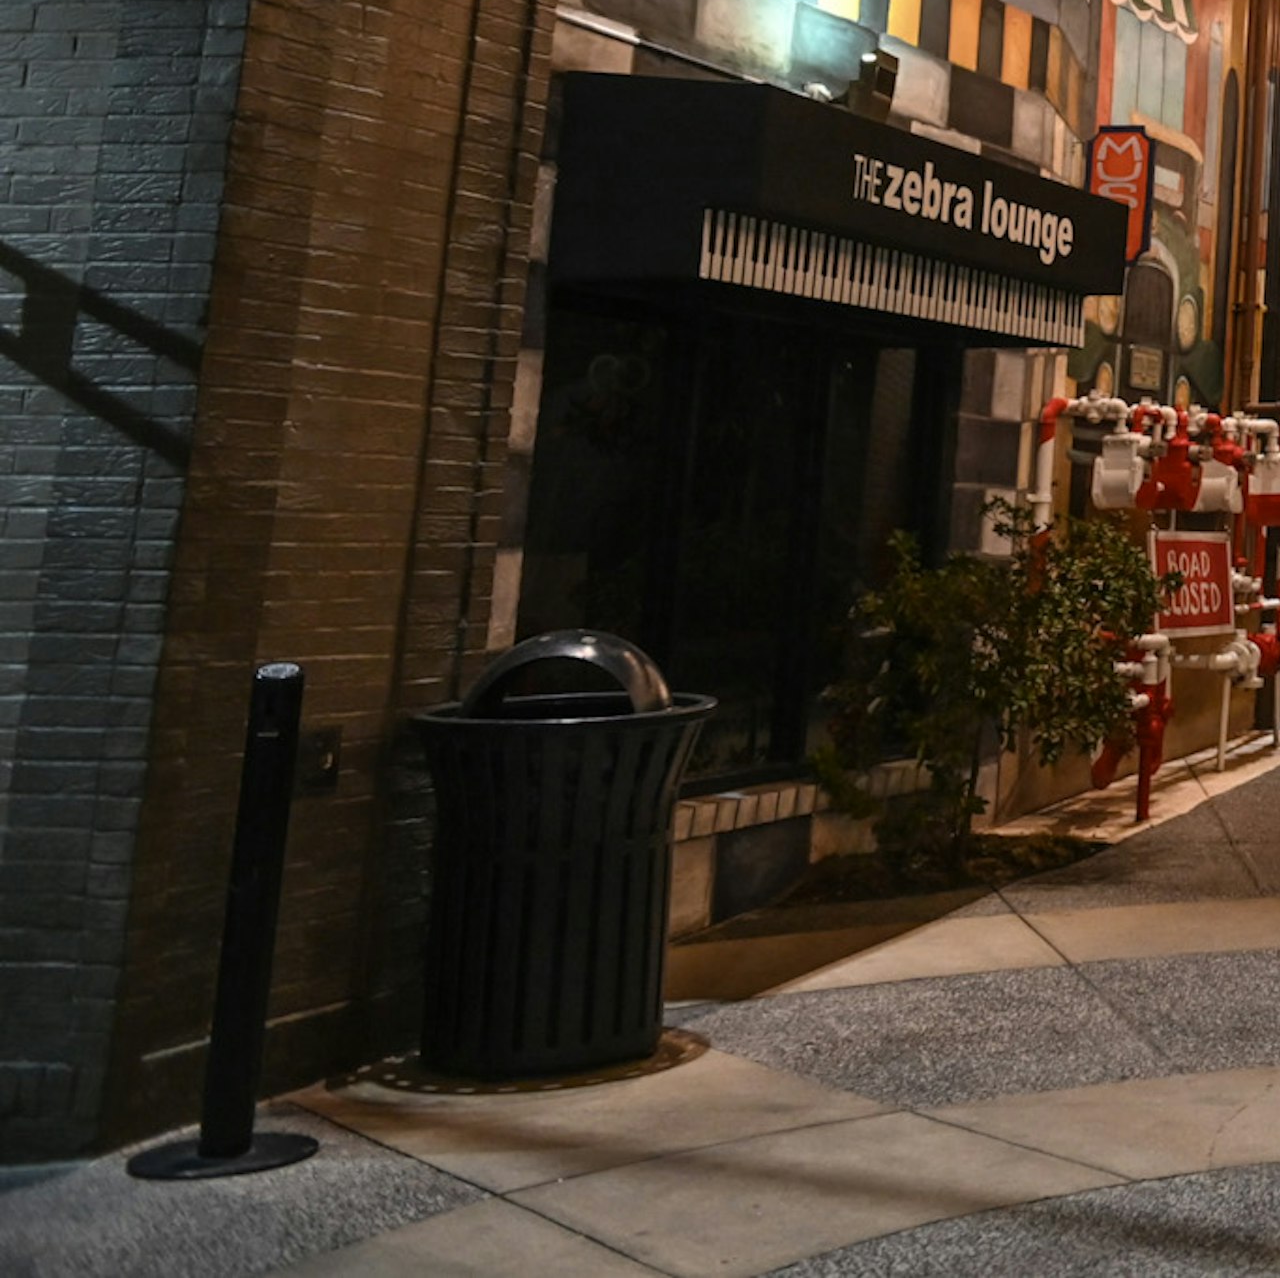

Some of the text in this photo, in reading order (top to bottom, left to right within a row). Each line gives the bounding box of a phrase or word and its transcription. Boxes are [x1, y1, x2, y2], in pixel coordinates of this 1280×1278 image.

[853, 153, 1074, 266] THE zebra lounge
